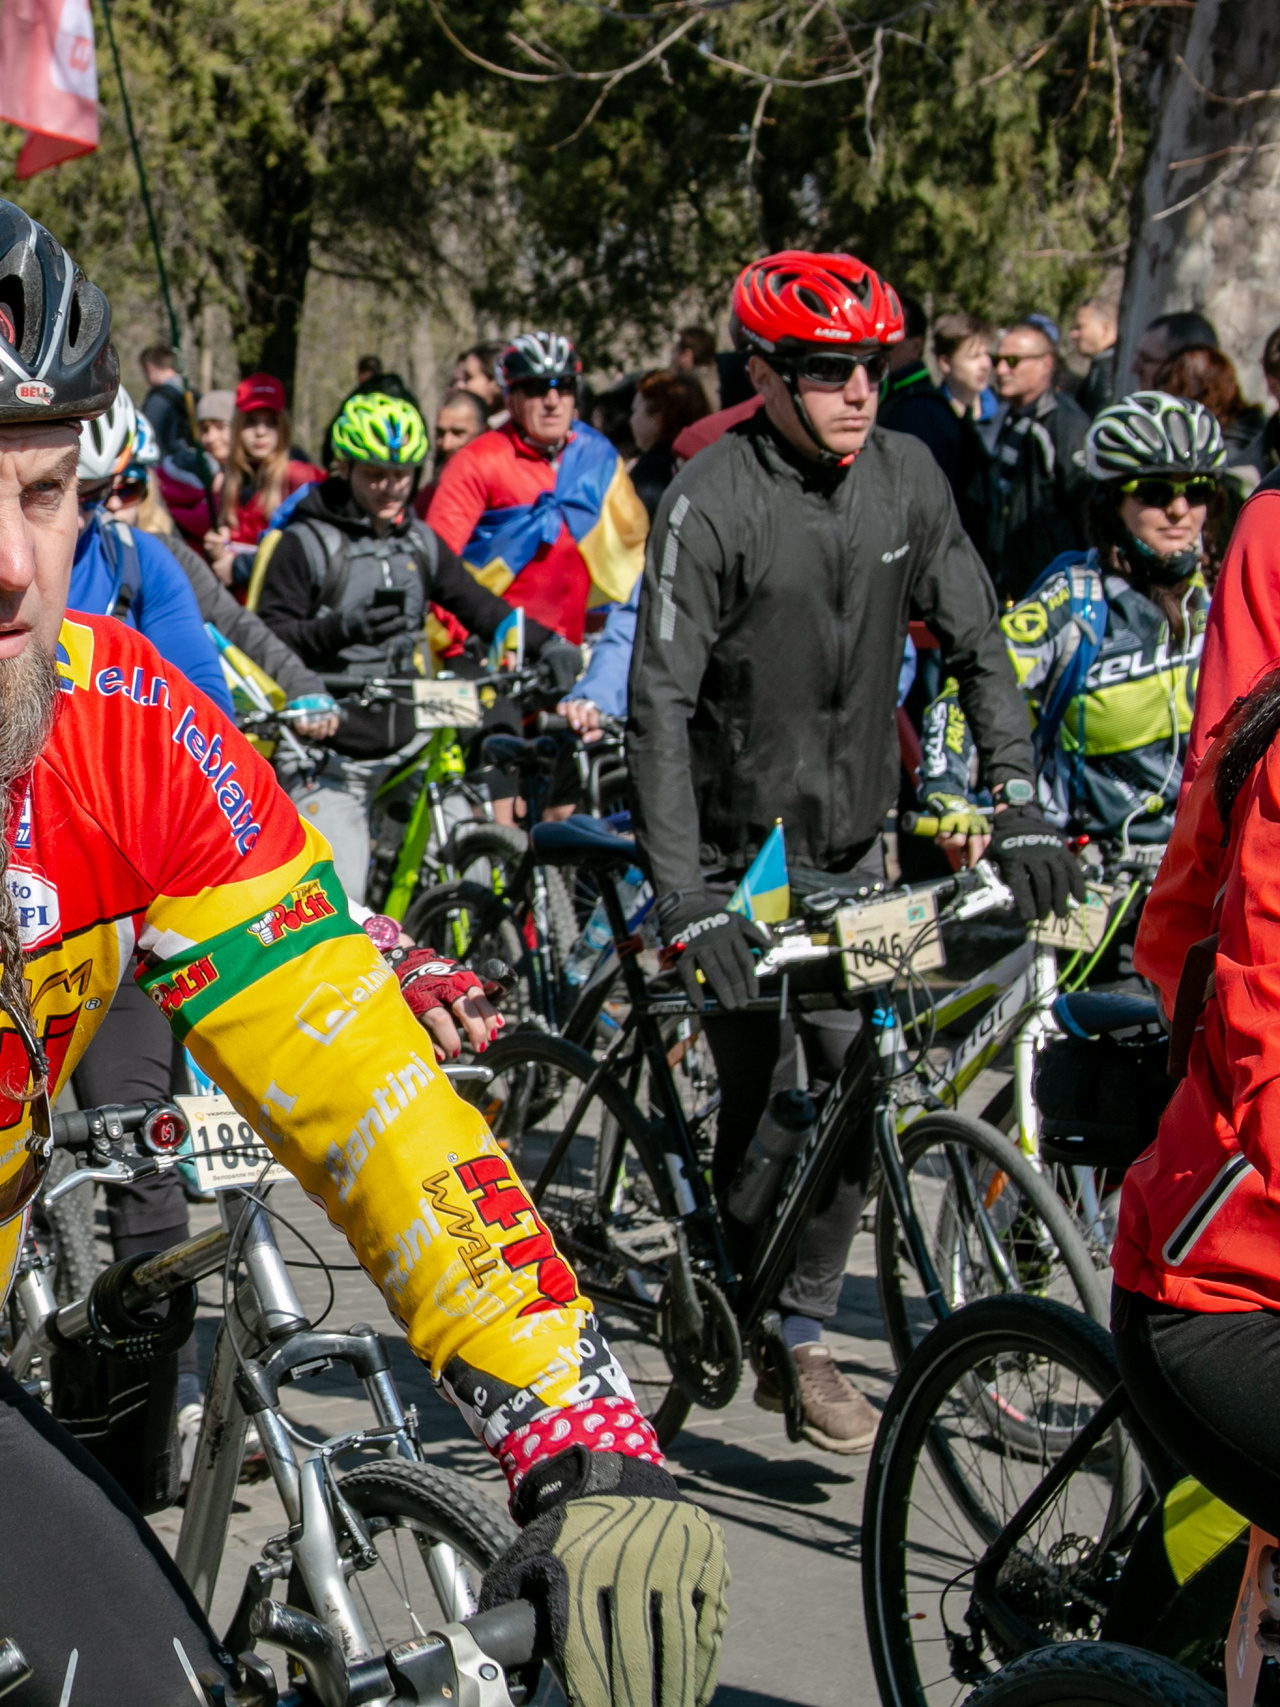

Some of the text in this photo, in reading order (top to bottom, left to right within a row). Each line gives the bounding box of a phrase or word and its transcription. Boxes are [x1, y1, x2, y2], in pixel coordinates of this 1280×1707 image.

[198, 1121, 269, 1171] 188
[324, 1051, 436, 1204] Santini
[422, 1169, 499, 1289] TEAM
